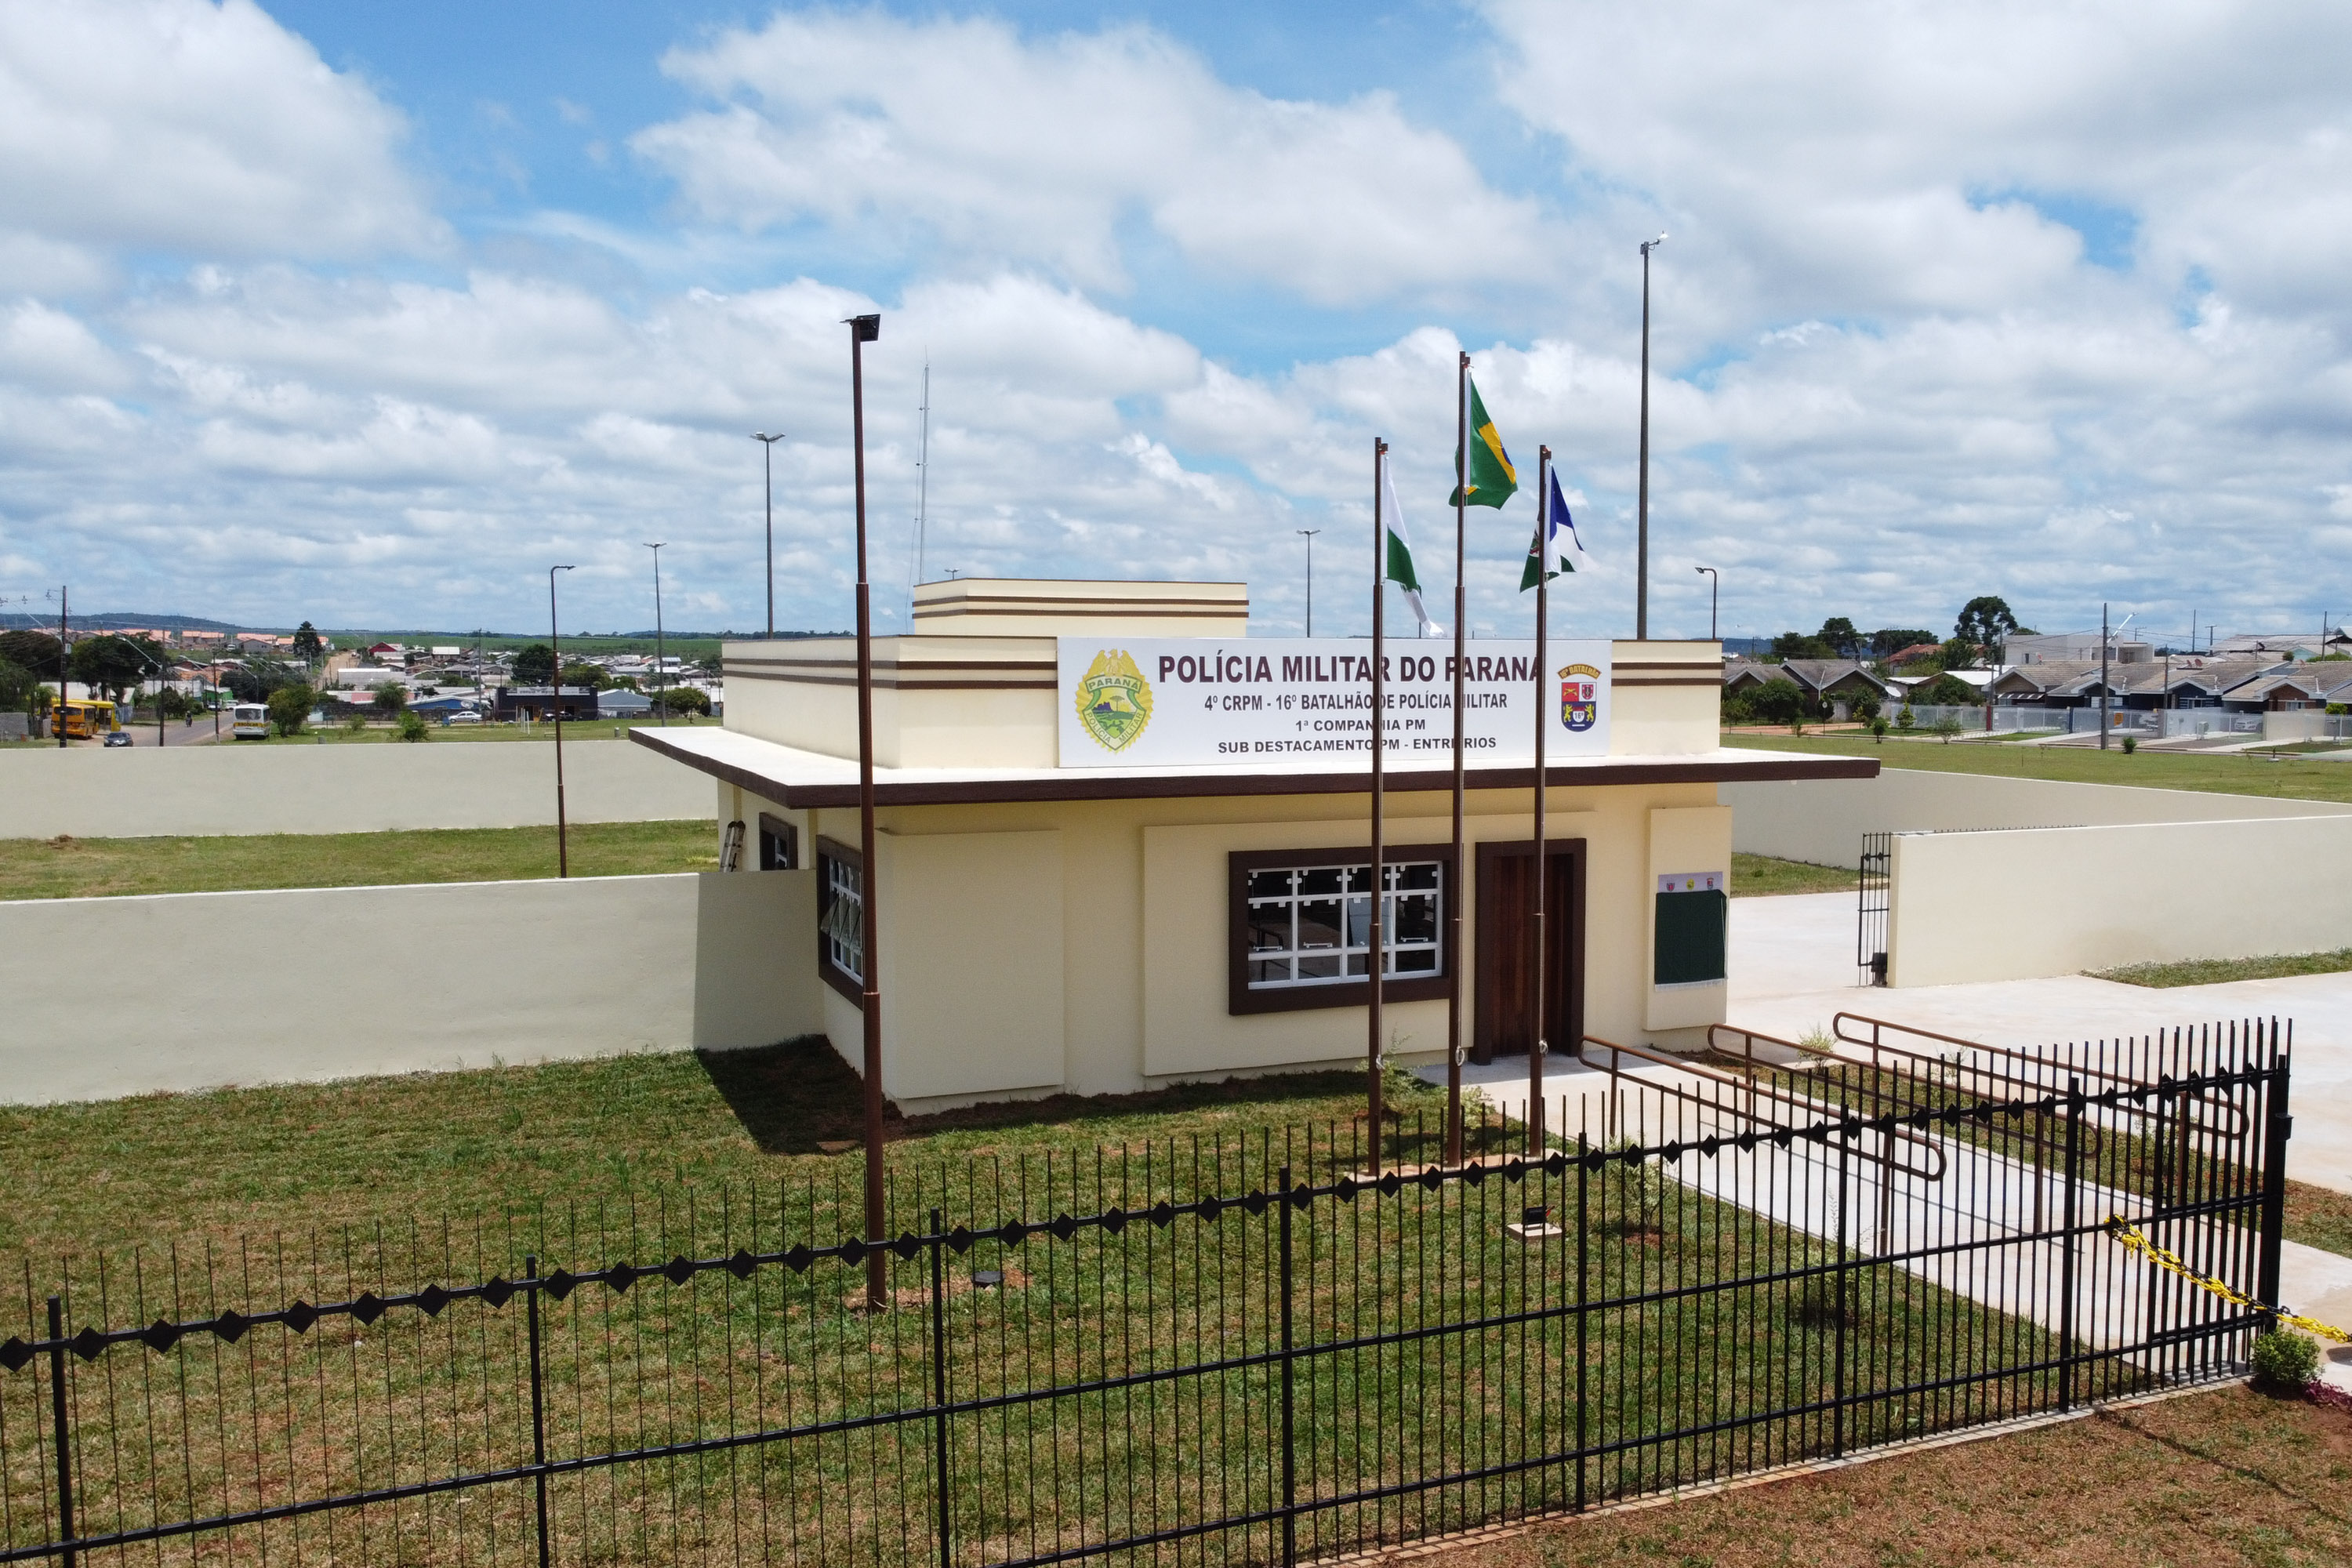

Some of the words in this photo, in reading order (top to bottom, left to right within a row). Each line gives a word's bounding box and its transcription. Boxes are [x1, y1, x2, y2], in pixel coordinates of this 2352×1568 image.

[1159, 649, 1273, 683] POLÍCIA
[1282, 655, 1392, 683] MILITAR
[1400, 656, 1436, 682] DO
[1088, 677, 1138, 690] PARANÁ
[1223, 695, 1263, 711] CRPM
[1301, 691, 1373, 710] BATALHÃO
[1399, 690, 1452, 710] POLÍCIA
[1462, 693, 1508, 708] ILITAR
[1120, 711, 1143, 743] MILITAR
[1406, 719, 1425, 730] PM
[1218, 742, 1249, 753] SUB
[1254, 739, 1374, 753] DESTACAMENTO
[1465, 737, 1496, 749] RIOS
